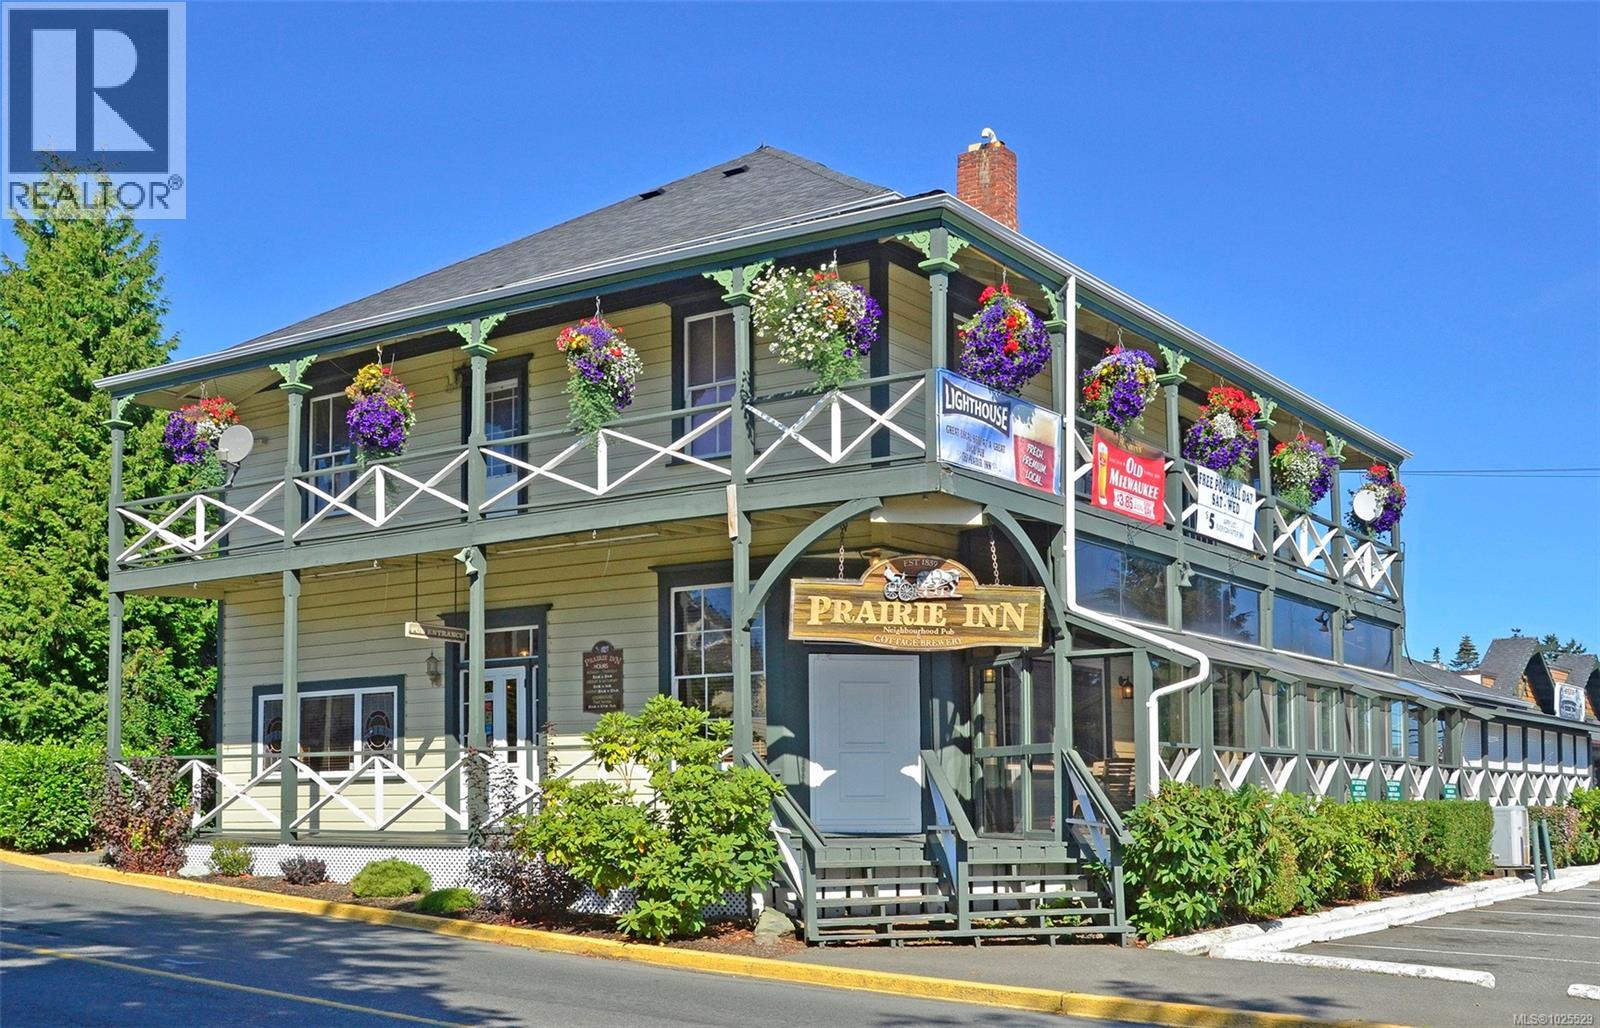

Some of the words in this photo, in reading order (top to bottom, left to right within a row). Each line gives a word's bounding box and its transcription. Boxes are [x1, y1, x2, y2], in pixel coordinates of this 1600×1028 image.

[945, 383, 1009, 431] LIGHTHOUSE
[1025, 470, 1043, 486] LOCAL
[1199, 472, 1214, 489] FREE
[1242, 490, 1253, 505] DAY
[1212, 493, 1223, 508] SAT
[1228, 500, 1240, 515] WED
[807, 595, 948, 627] PRAIRIE
[962, 602, 1029, 631] INN
[426, 628, 465, 639] ENTRANCE
[883, 625, 939, 636] Neighbourhood
[941, 628, 955, 636] Pub
[873, 634, 919, 647] COTTAGE
[920, 637, 962, 647] BREWERY
